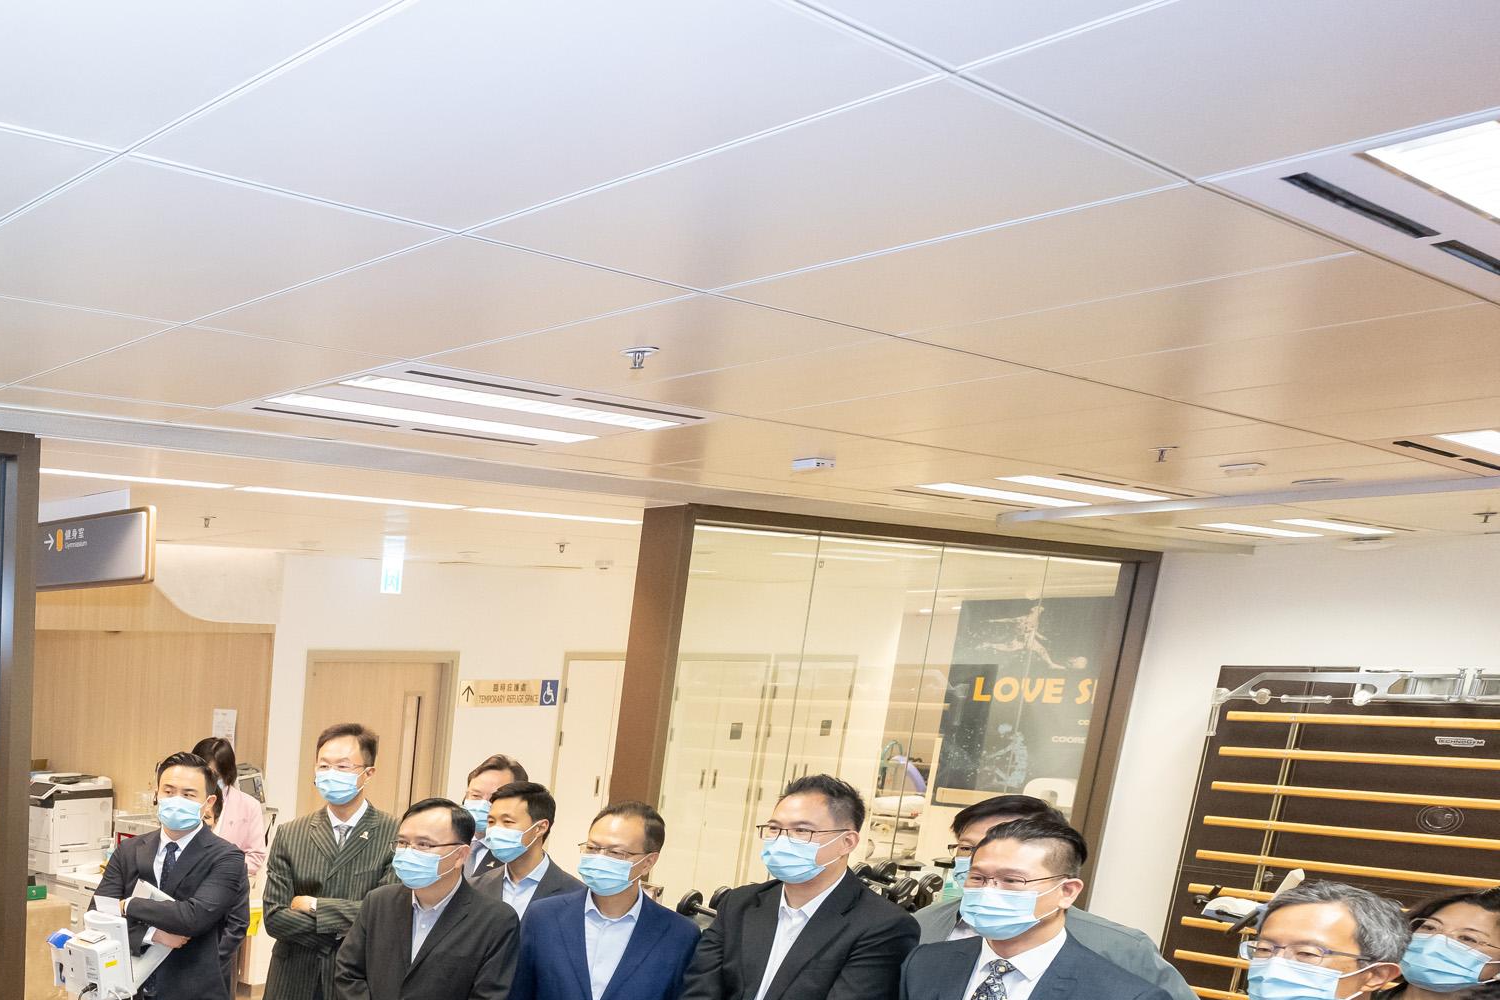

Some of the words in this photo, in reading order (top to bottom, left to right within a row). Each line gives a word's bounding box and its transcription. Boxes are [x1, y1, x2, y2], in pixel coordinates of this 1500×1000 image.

[478, 694, 506, 704] TEMPORARY
[524, 694, 539, 704] SPACE
[972, 676, 1066, 704] LOVE
